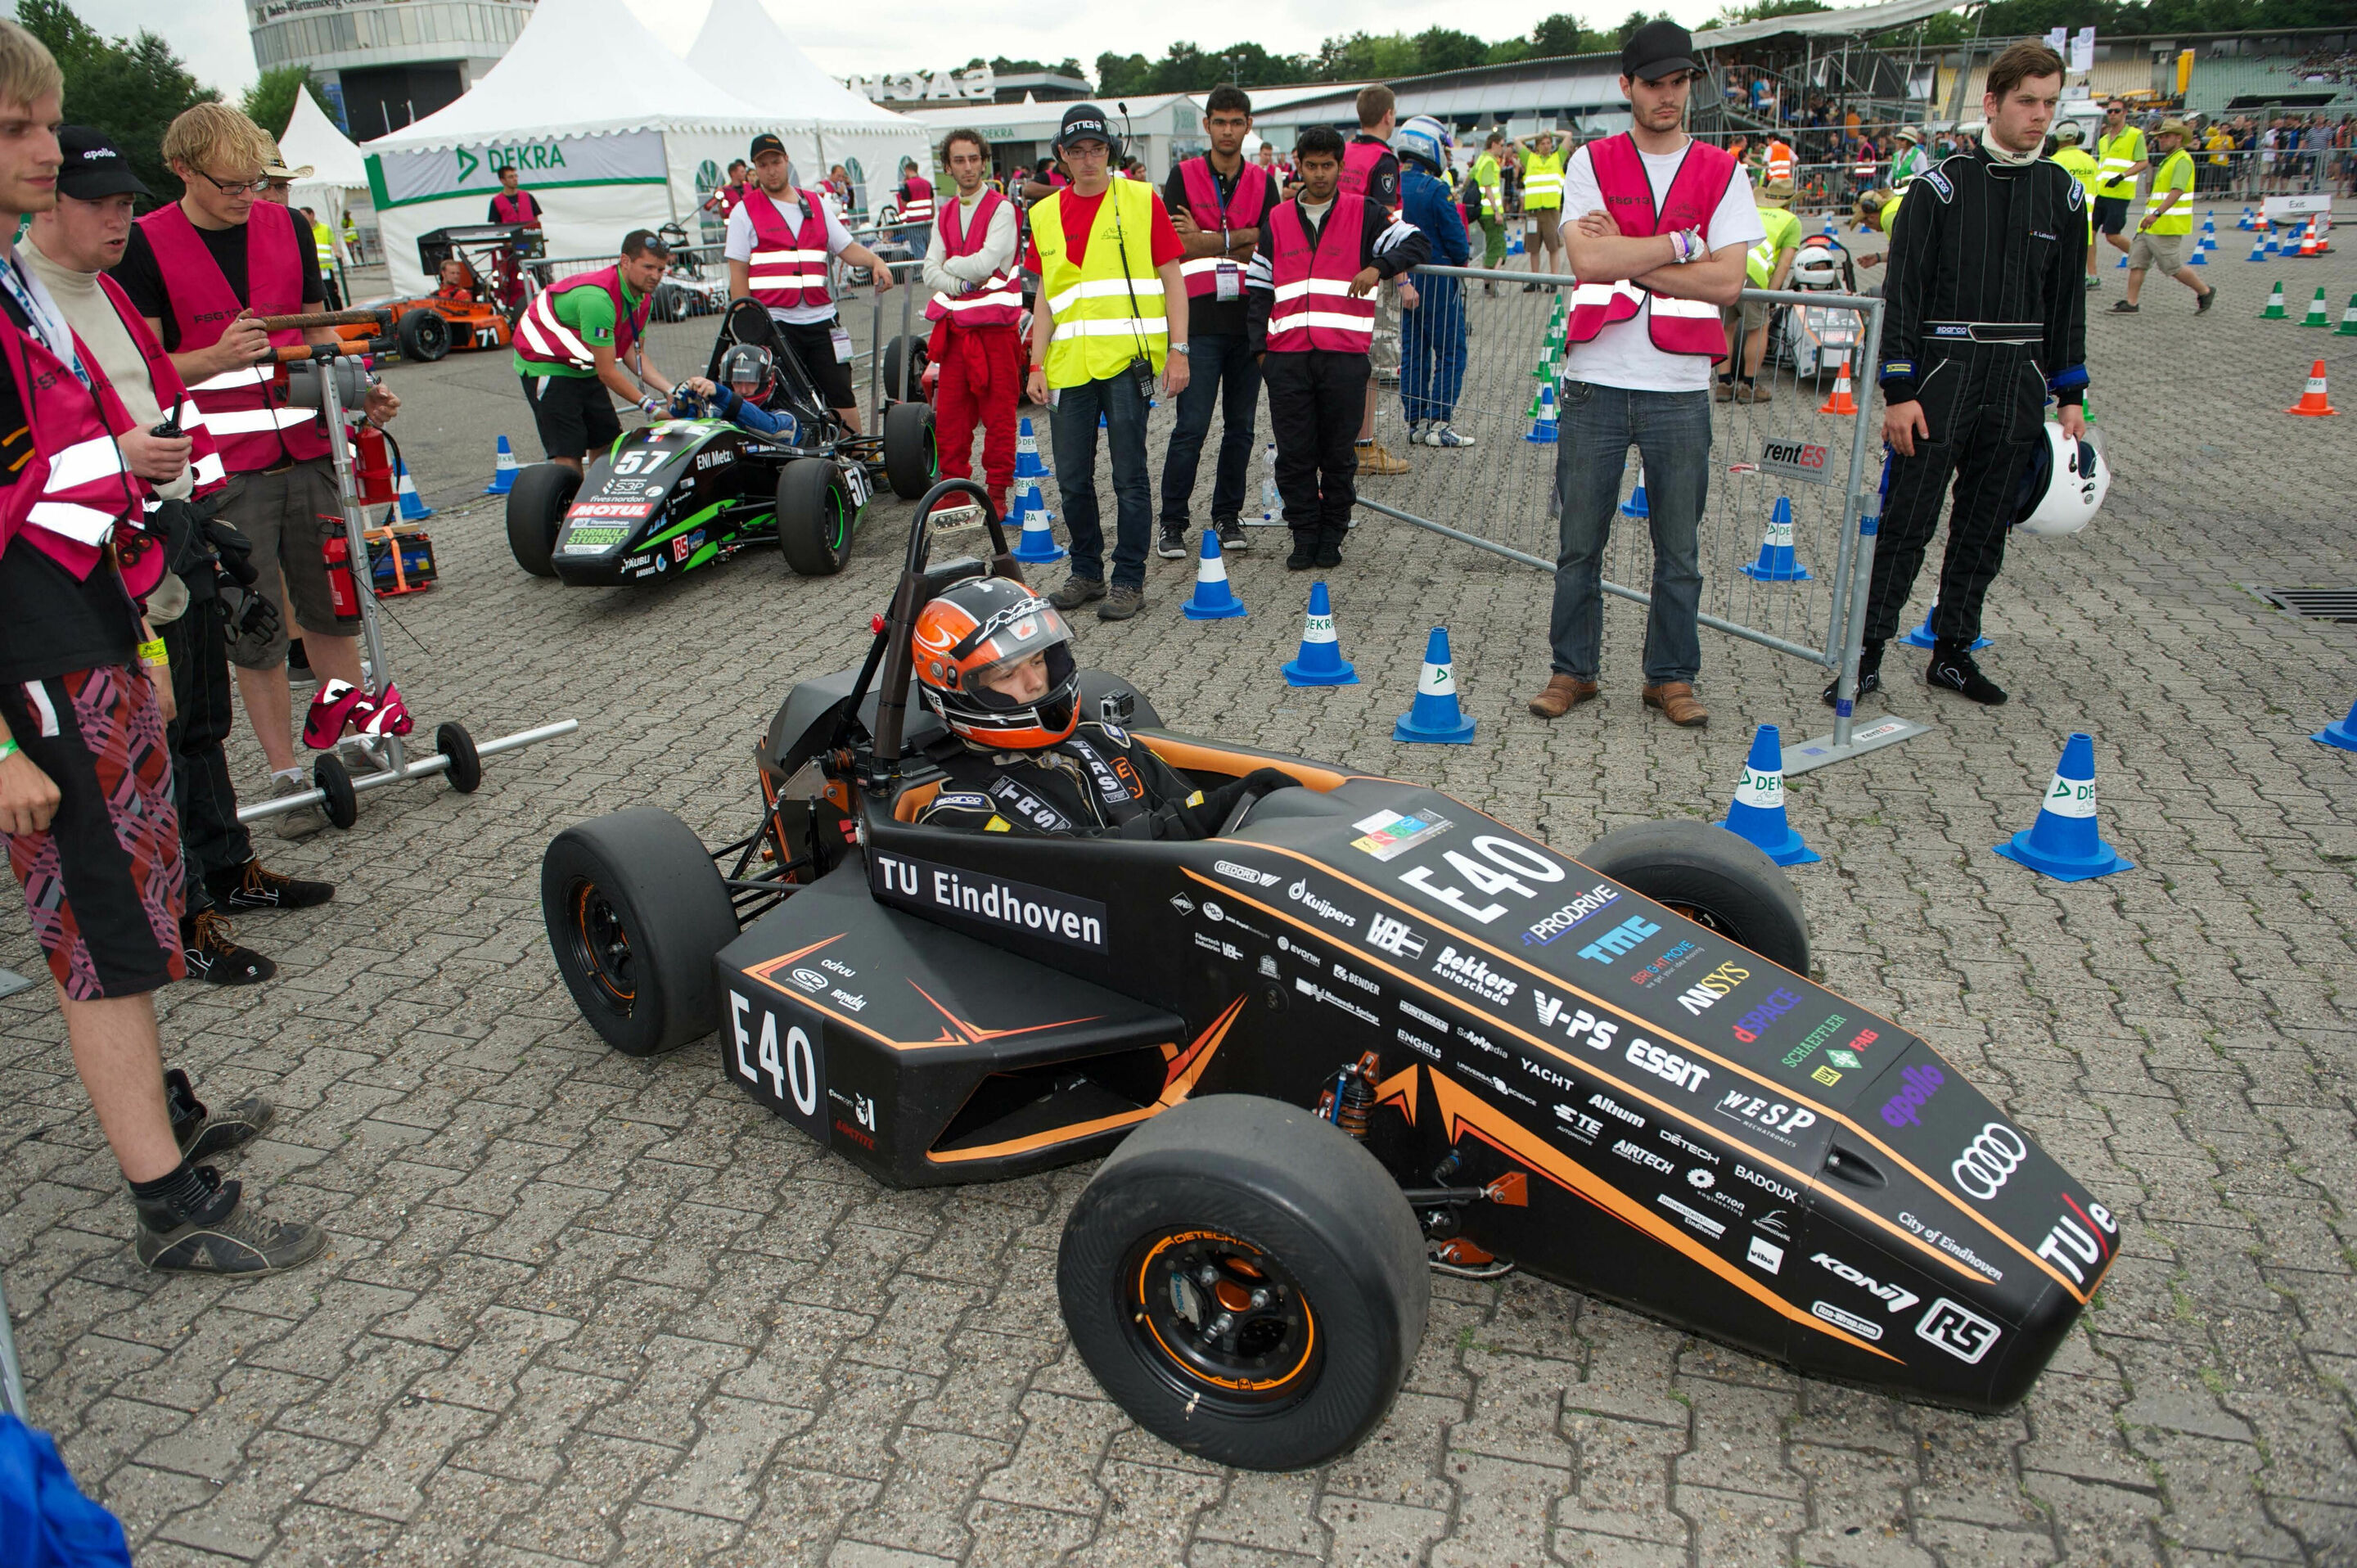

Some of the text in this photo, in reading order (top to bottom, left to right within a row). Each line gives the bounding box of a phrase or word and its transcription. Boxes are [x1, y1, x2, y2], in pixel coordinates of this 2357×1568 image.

[981, 128, 1015, 138] DEKRA
[83, 147, 116, 160] apollo
[488, 144, 566, 173] DEKRA
[2289, 200, 2306, 209] Exit
[710, 292, 726, 307] 53
[476, 327, 499, 347] 71
[1936, 326, 1967, 335] sparco
[614, 450, 671, 475] 57
[696, 449, 732, 471] ENI Metz
[1764, 443, 1827, 469] rentES
[614, 483, 645, 491] S3P
[845, 466, 867, 507] 57
[572, 505, 646, 516] MOTUL
[567, 536, 624, 544] STUDENT
[572, 529, 629, 537] FORMULA
[674, 537, 689, 558] RS
[1862, 725, 1895, 739] rentES
[1079, 748, 1118, 791] TRS
[935, 795, 981, 806] sparco
[998, 783, 1056, 828] TRS
[1217, 862, 1258, 881] GEDORE
[1398, 836, 1565, 925] E40
[878, 856, 1102, 945] TU Eindhoven
[1301, 891, 1356, 928] Kuijpers
[1530, 884, 1619, 940] PRODRIVE
[1195, 932, 1220, 947] Fibertech
[1195, 939, 1221, 953] Industries
[1437, 945, 1518, 996] Bekkers
[1630, 939, 1695, 985] BRIGHTMOVE
[1349, 971, 1381, 996] BENDER
[1431, 964, 1510, 1007] Autoschade
[1677, 960, 1751, 1016] ANSYS
[1324, 990, 1380, 1023] Merwede Springs
[1400, 1000, 1449, 1032] HUNTSMAN
[1533, 989, 1619, 1051] V-PS
[1732, 986, 1803, 1043] dSPACE
[729, 989, 818, 1116] E40
[1397, 1029, 1442, 1059] ENGELS
[1782, 1014, 1846, 1068] SCHAEFFLER
[1849, 1028, 1879, 1052] FAG
[1521, 1057, 1575, 1091] YACHT
[1625, 1039, 1710, 1093] ESSIT
[1457, 1061, 1538, 1106] UNIVERSAL SCIENCE
[1880, 1064, 1945, 1129] apollo
[1578, 1113, 1603, 1135] TE
[1588, 1093, 1646, 1128] Altium
[1722, 1089, 1817, 1136] WESP
[836, 1119, 874, 1150] LOCTITE
[1557, 1125, 1593, 1146] AUTOMOTIVE
[1742, 1119, 1797, 1149] MECHATRONICS
[1613, 1139, 1675, 1174] AIRTECH
[1734, 1164, 1799, 1204] BADOUX
[1661, 1195, 1724, 1234] Universiteitsfonds
[1697, 1191, 1744, 1217] engineering
[1715, 1192, 1745, 1211] orion
[1684, 1216, 1720, 1241] Eindhoven
[1751, 1219, 1791, 1242] AutomotiveNL
[2035, 1192, 2117, 1285] TU/e
[1751, 1250, 1774, 1266] viba
[1899, 1211, 2003, 1282] City of Eindhoven
[1926, 1305, 1992, 1357] RS
